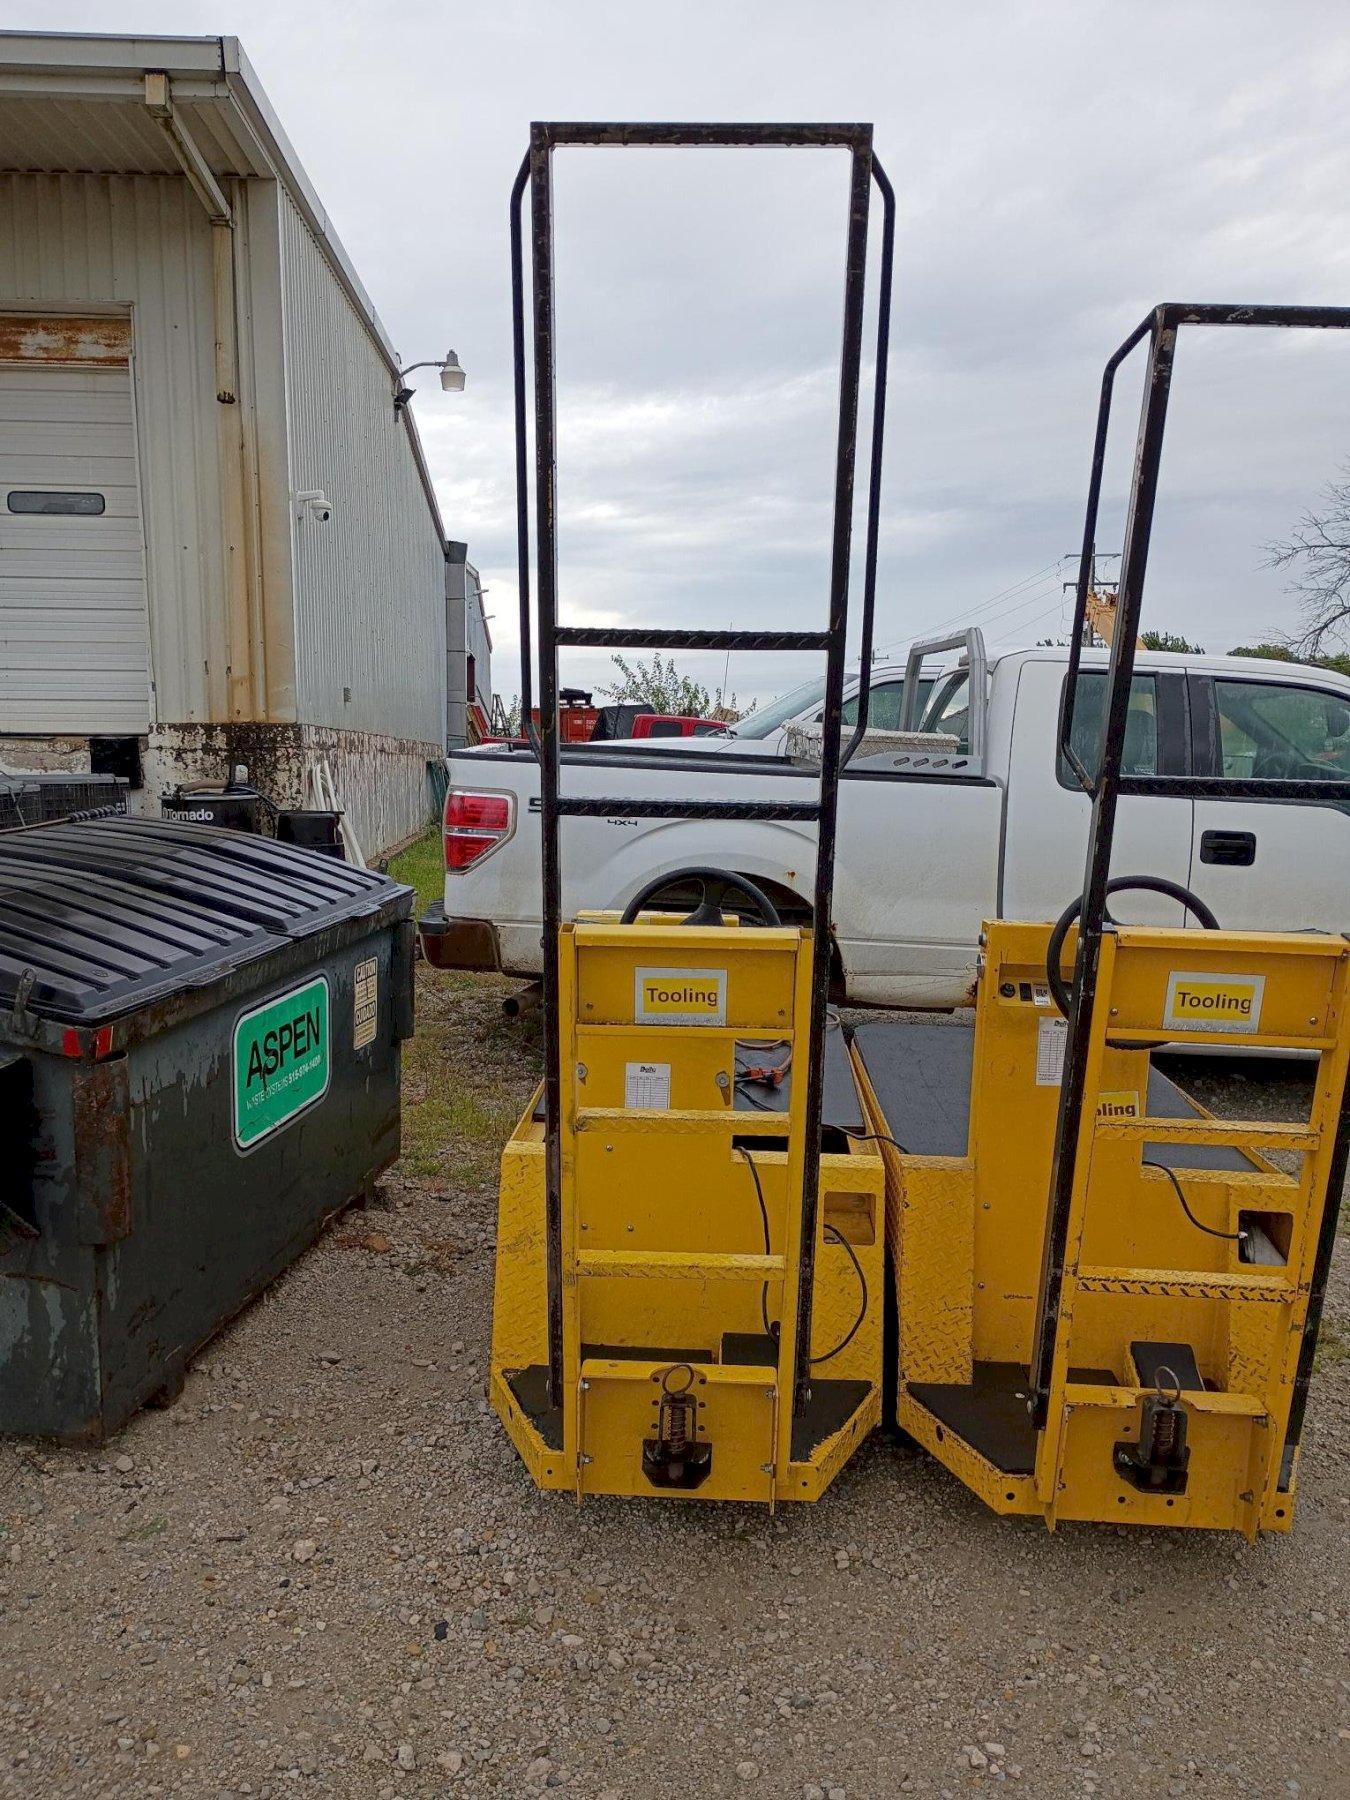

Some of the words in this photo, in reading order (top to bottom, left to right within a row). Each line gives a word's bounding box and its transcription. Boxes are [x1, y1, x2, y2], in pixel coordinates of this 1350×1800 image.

[167, 808, 214, 821] Tornado
[646, 987, 718, 1007] Tooling
[1178, 991, 1252, 1014] Tooling
[246, 1006, 320, 1088] ASPEN
